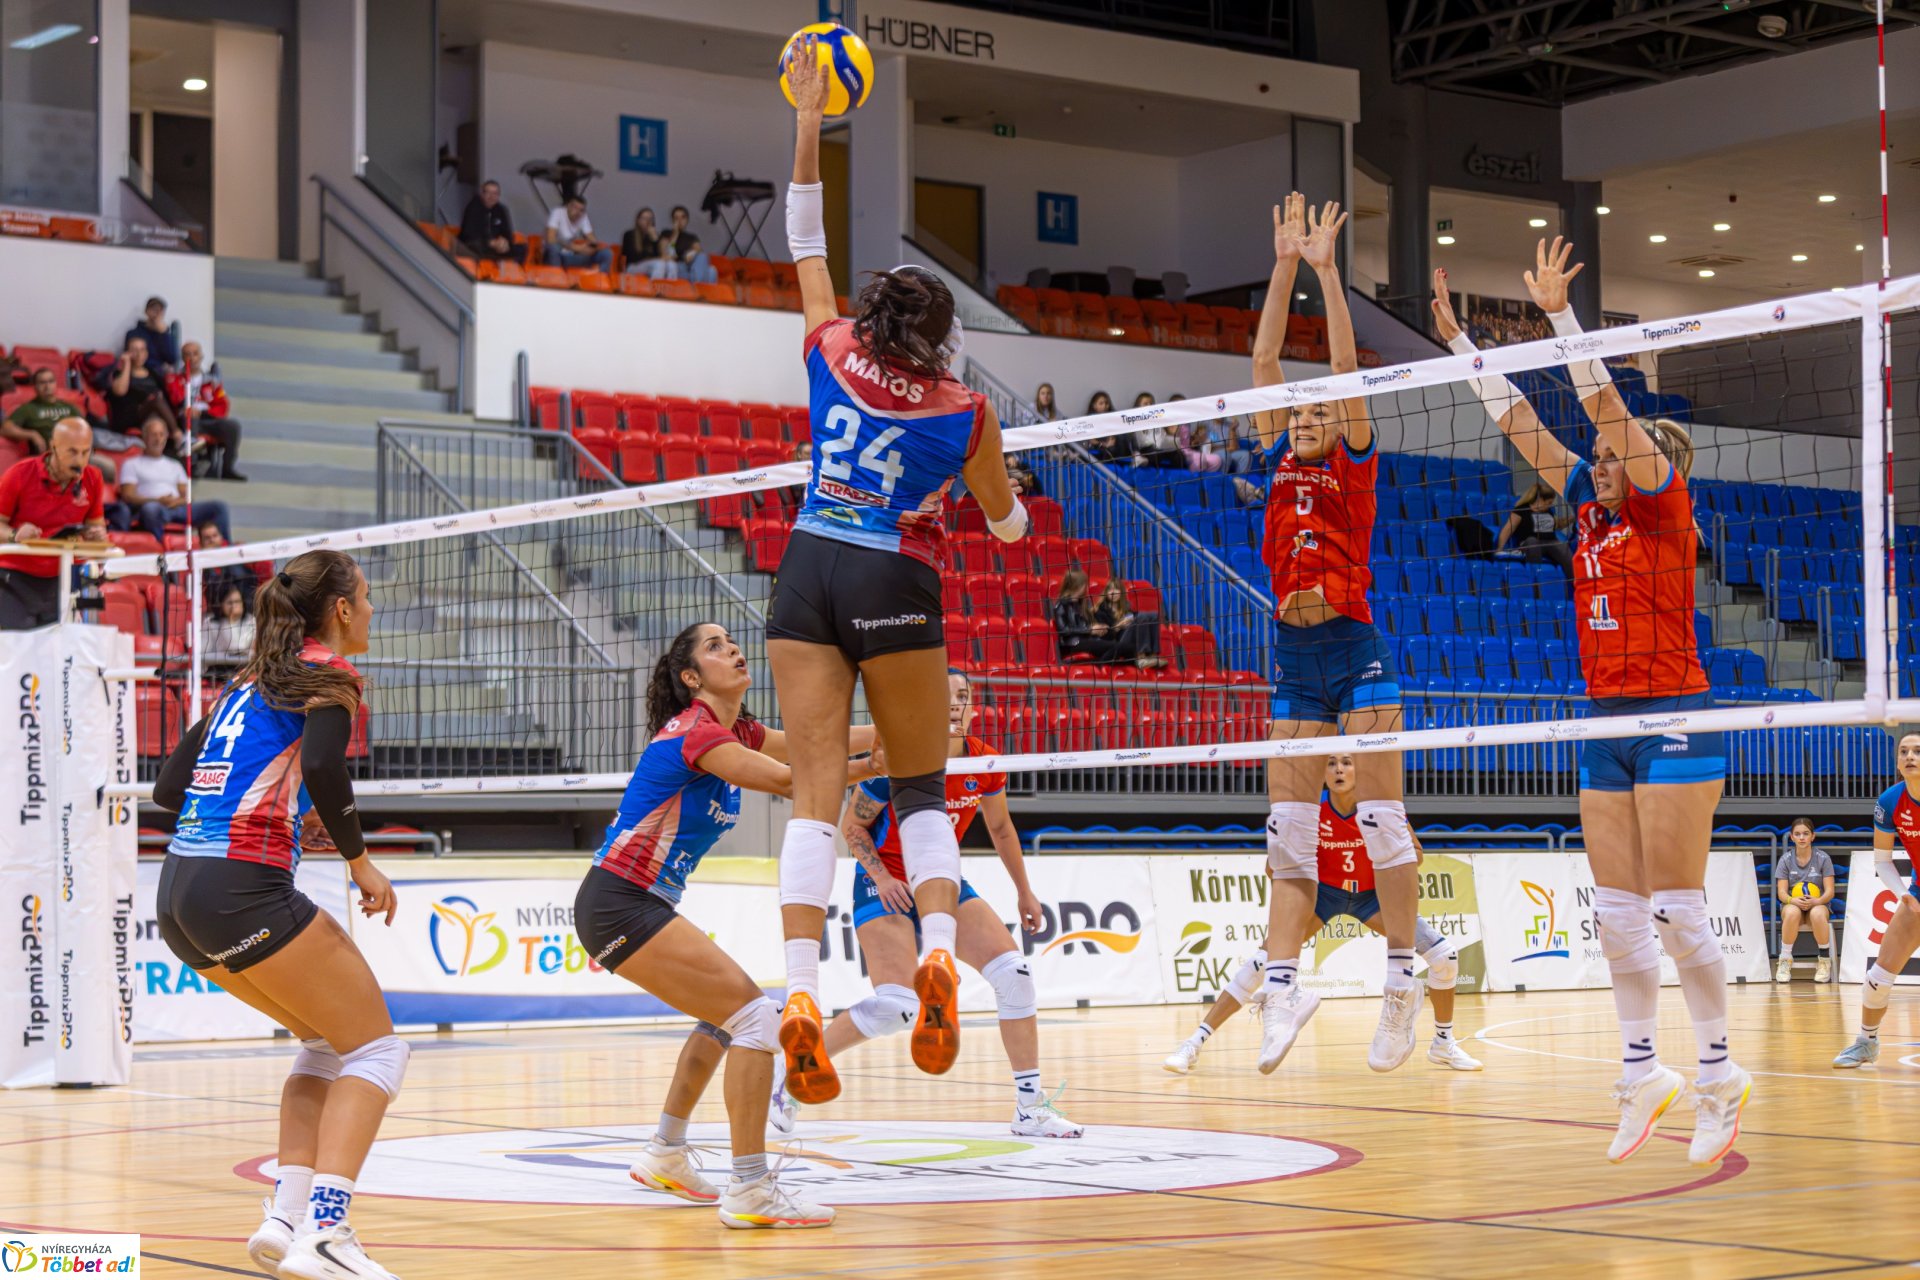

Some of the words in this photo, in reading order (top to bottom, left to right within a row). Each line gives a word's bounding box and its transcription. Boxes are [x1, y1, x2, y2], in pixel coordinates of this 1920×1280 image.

[864, 14, 995, 60] HÜBNER
[1642, 319, 1702, 341] TippmixPRO
[1362, 367, 1412, 387] TippmixPRO
[820, 404, 906, 495] 24
[1295, 485, 1314, 516] 5
[852, 614, 928, 631] TippmixPRO
[62, 656, 74, 755] TippmixPRO
[20, 672, 47, 826] TippmixPRO
[1662, 742, 1689, 752] nine
[62, 802, 74, 902] TippmixPRO
[1342, 850, 1356, 873] 3
[1190, 869, 1268, 908] Körny
[517, 902, 576, 928] NYÍRE
[1225, 924, 1237, 941] a
[22, 894, 50, 1048] TippmixPRO
[113, 894, 133, 1044] TippmixPRO
[61, 949, 73, 1050] TippmixPRO
